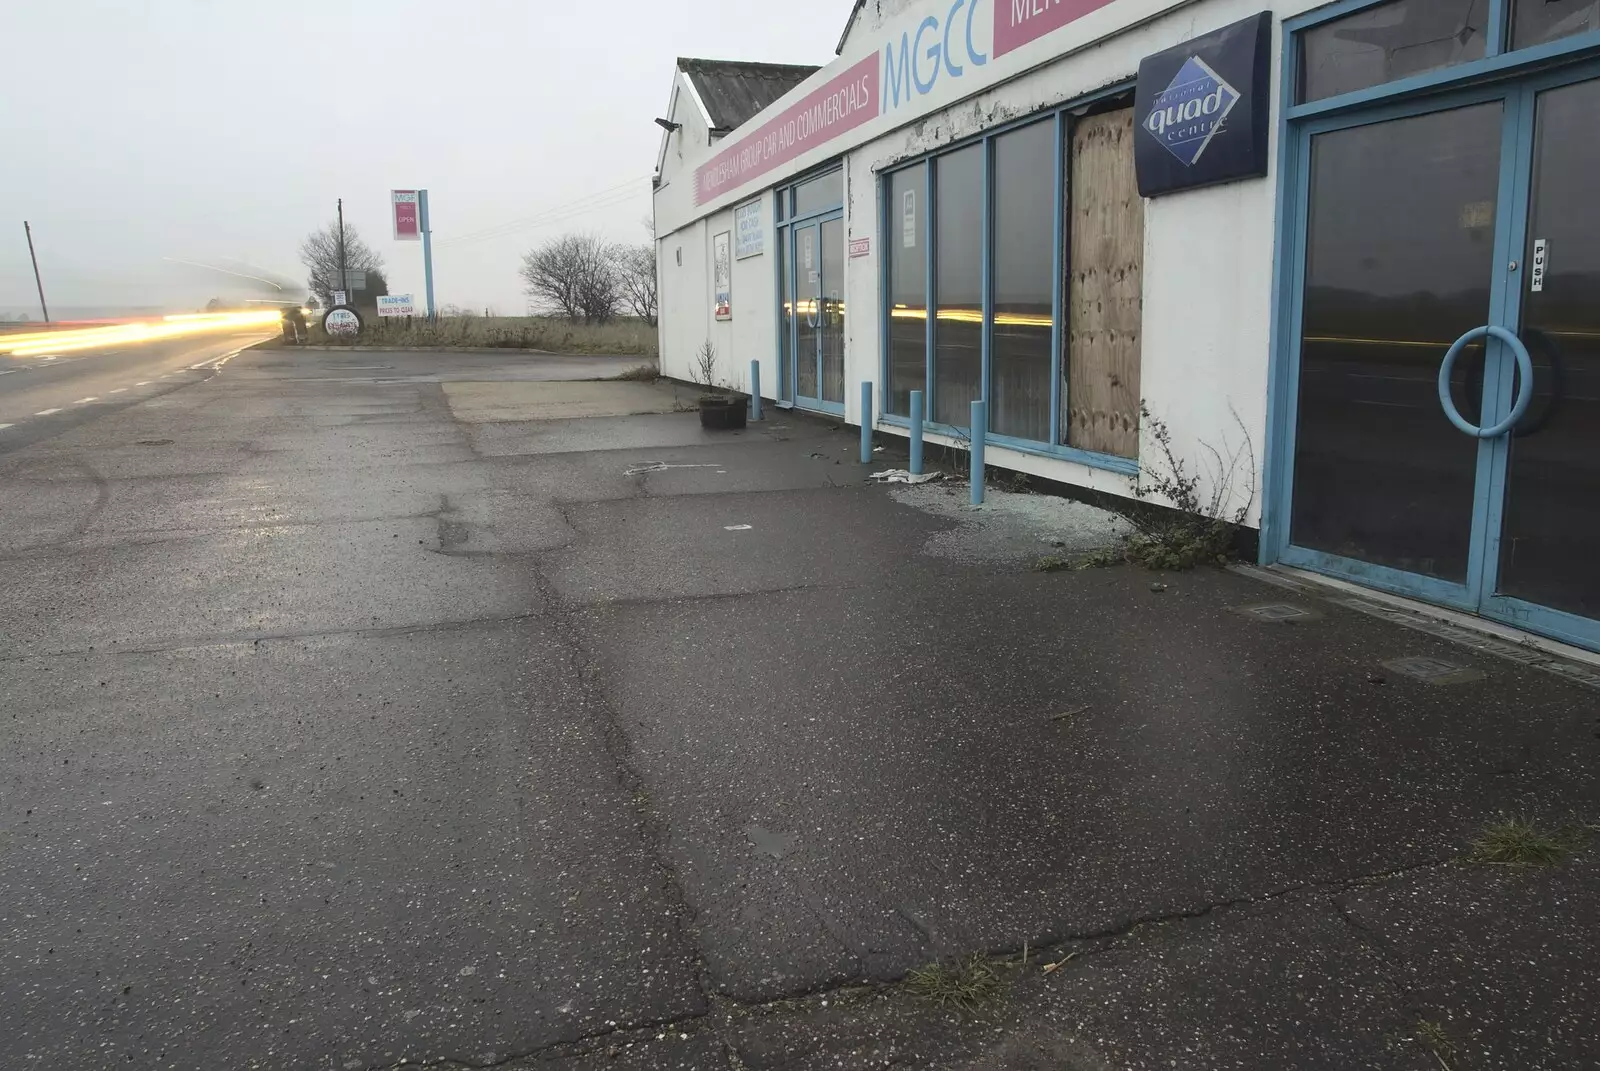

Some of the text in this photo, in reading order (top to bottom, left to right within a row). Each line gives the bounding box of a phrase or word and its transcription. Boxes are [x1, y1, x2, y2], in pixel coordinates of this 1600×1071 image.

[883, 0, 987, 114] MGCC
[741, 140, 762, 173] GROUP
[763, 131, 778, 160] CAR
[778, 120, 796, 150] AND
[796, 75, 869, 141] COMMERCIALS
[1148, 84, 1223, 135] quad
[1167, 117, 1228, 140] centre
[1533, 246, 1544, 286] PUSH
[381, 296, 410, 304] TRADE-INS
